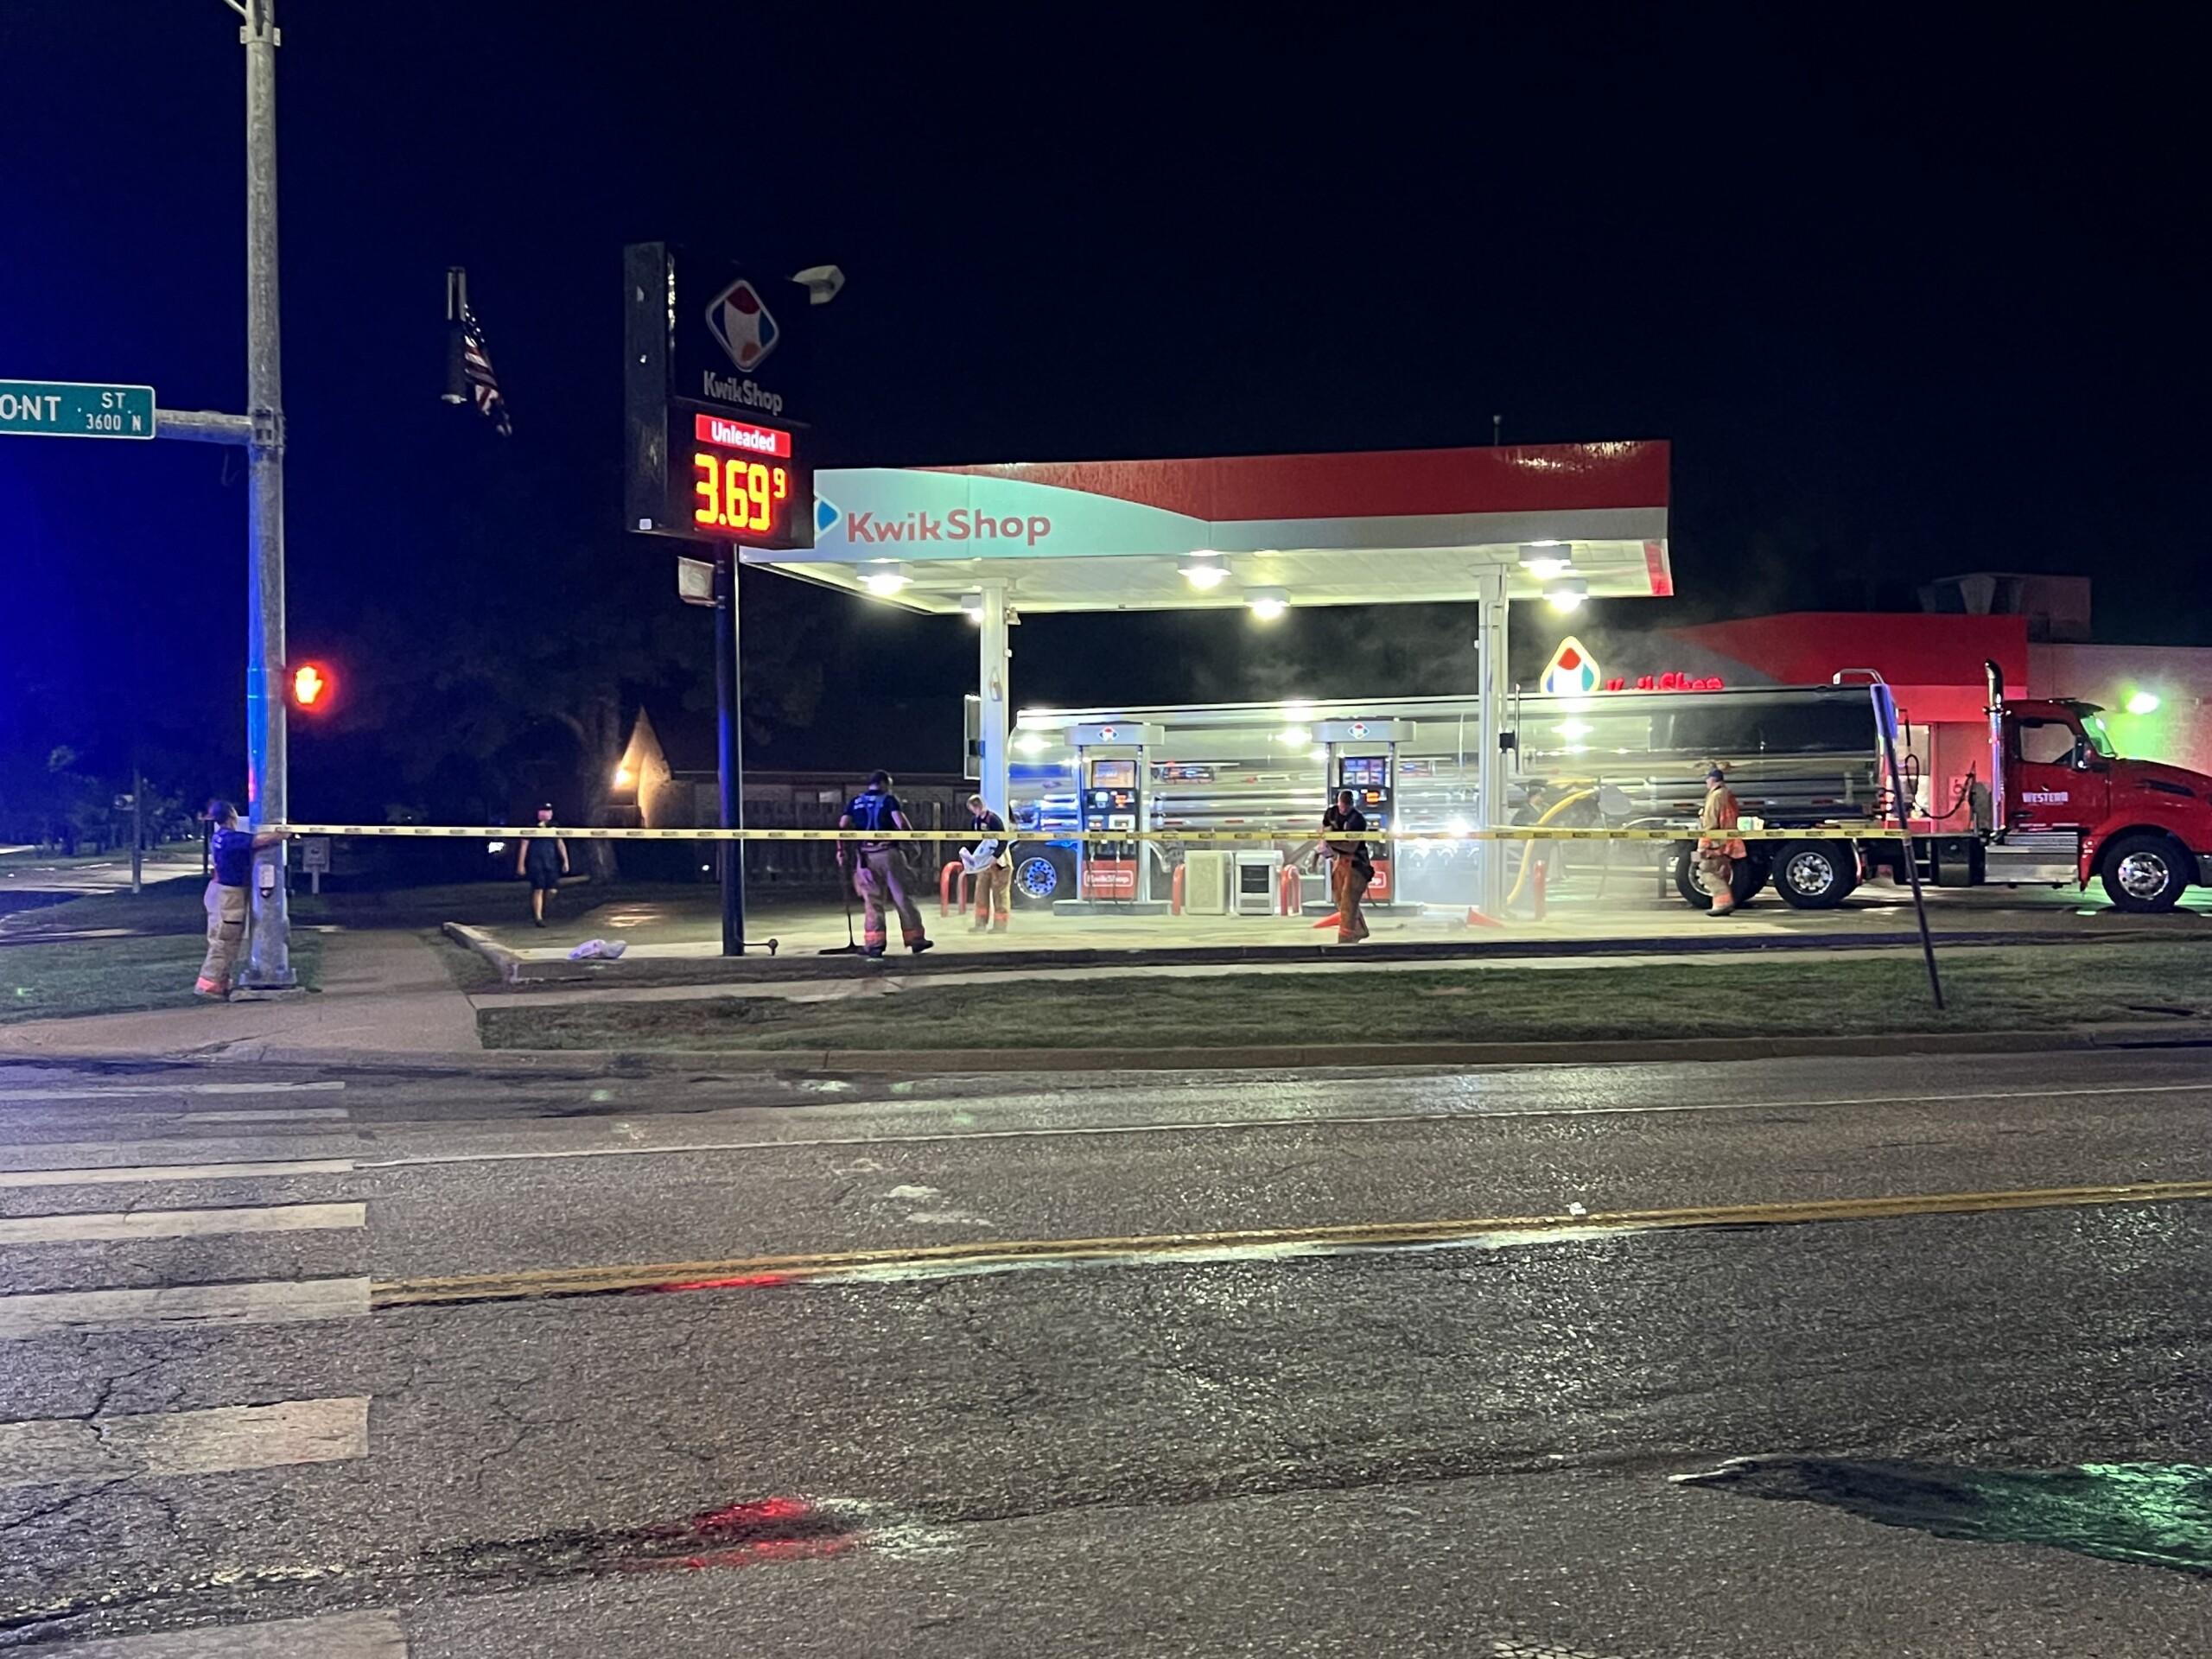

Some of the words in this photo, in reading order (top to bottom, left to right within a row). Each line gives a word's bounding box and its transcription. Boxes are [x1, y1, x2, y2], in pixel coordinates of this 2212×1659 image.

[0, 394, 60, 422] ONT
[101, 392, 126, 410] ST
[703, 370, 783, 416] KwikShop
[86, 414, 121, 431] 3600
[131, 415, 142, 431] N
[711, 421, 776, 452] Unleaded
[695, 453, 770, 531] 3.69
[847, 509, 1052, 546] KwikShop
